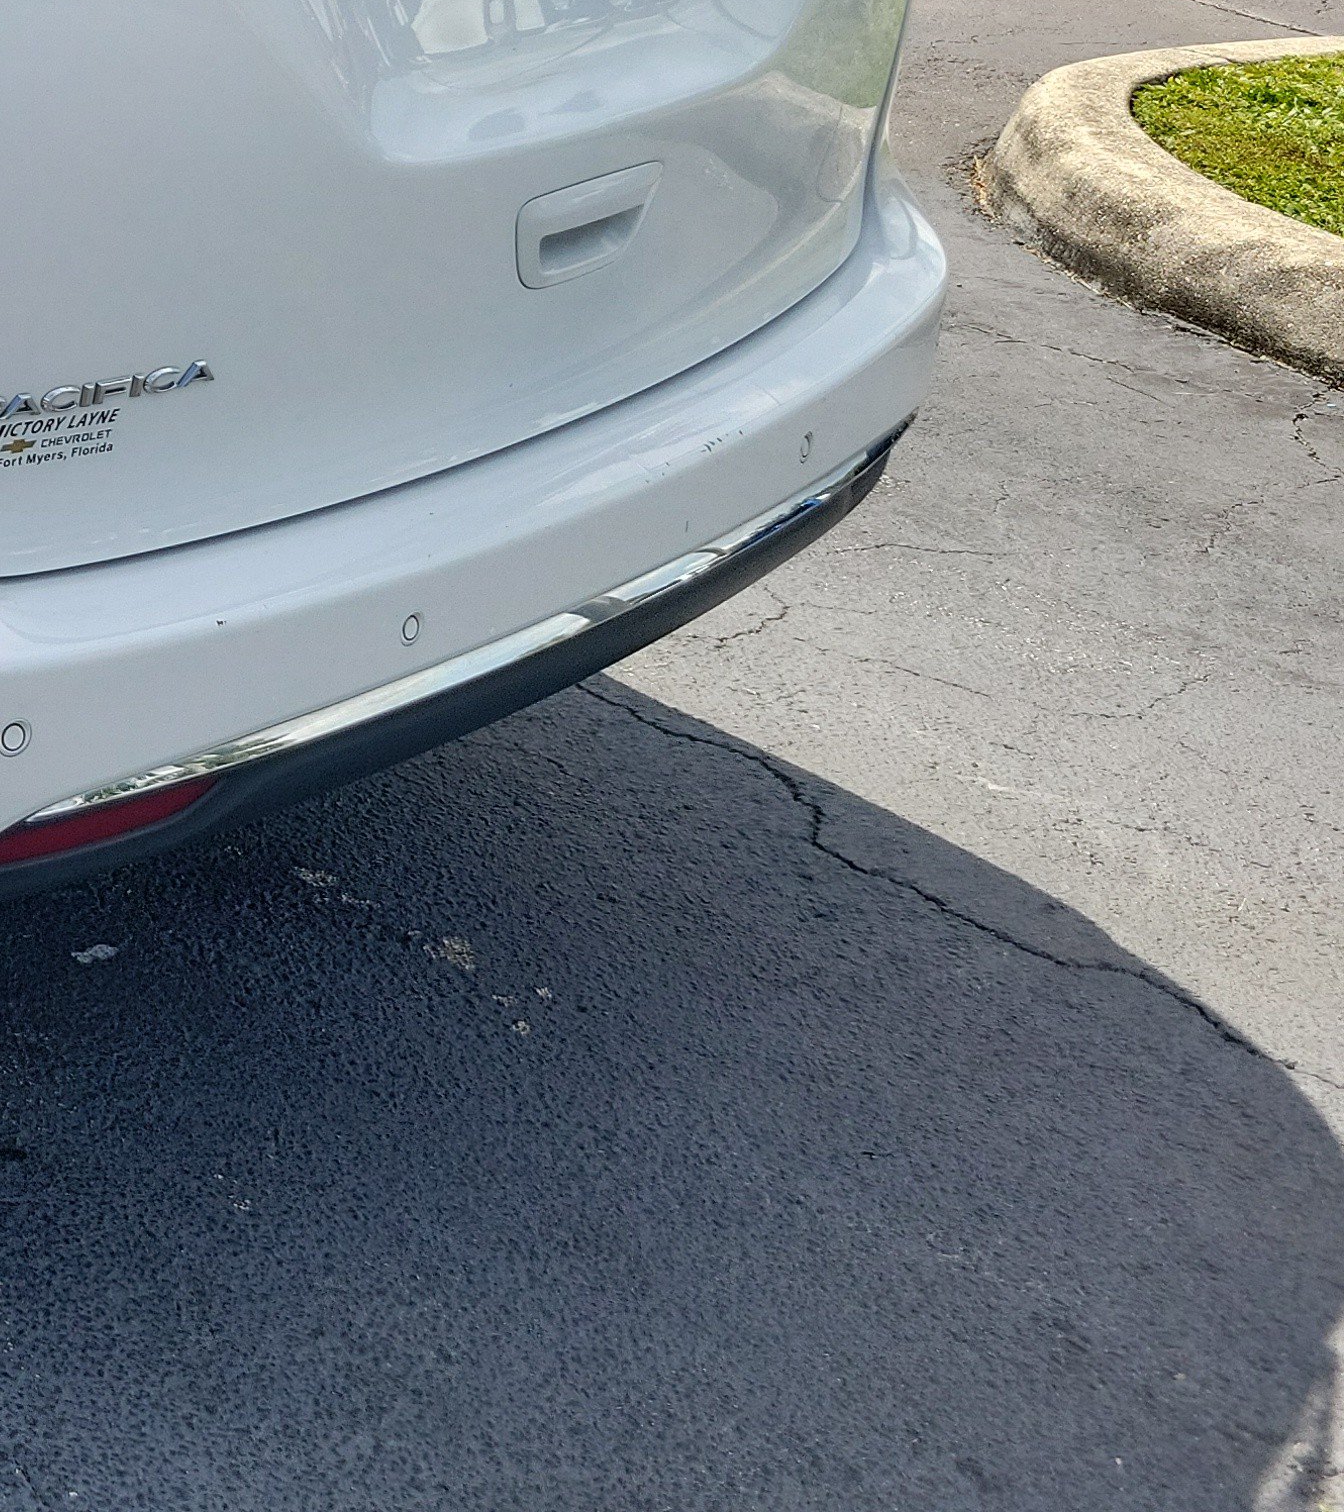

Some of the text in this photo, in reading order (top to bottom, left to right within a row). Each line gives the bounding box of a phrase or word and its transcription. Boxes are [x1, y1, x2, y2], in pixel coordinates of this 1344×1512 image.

[67, 408, 121, 429] LAYNE
[40, 429, 112, 448] CHEVROLET
[26, 450, 68, 466] Myers,
[71, 442, 114, 458] Florida
